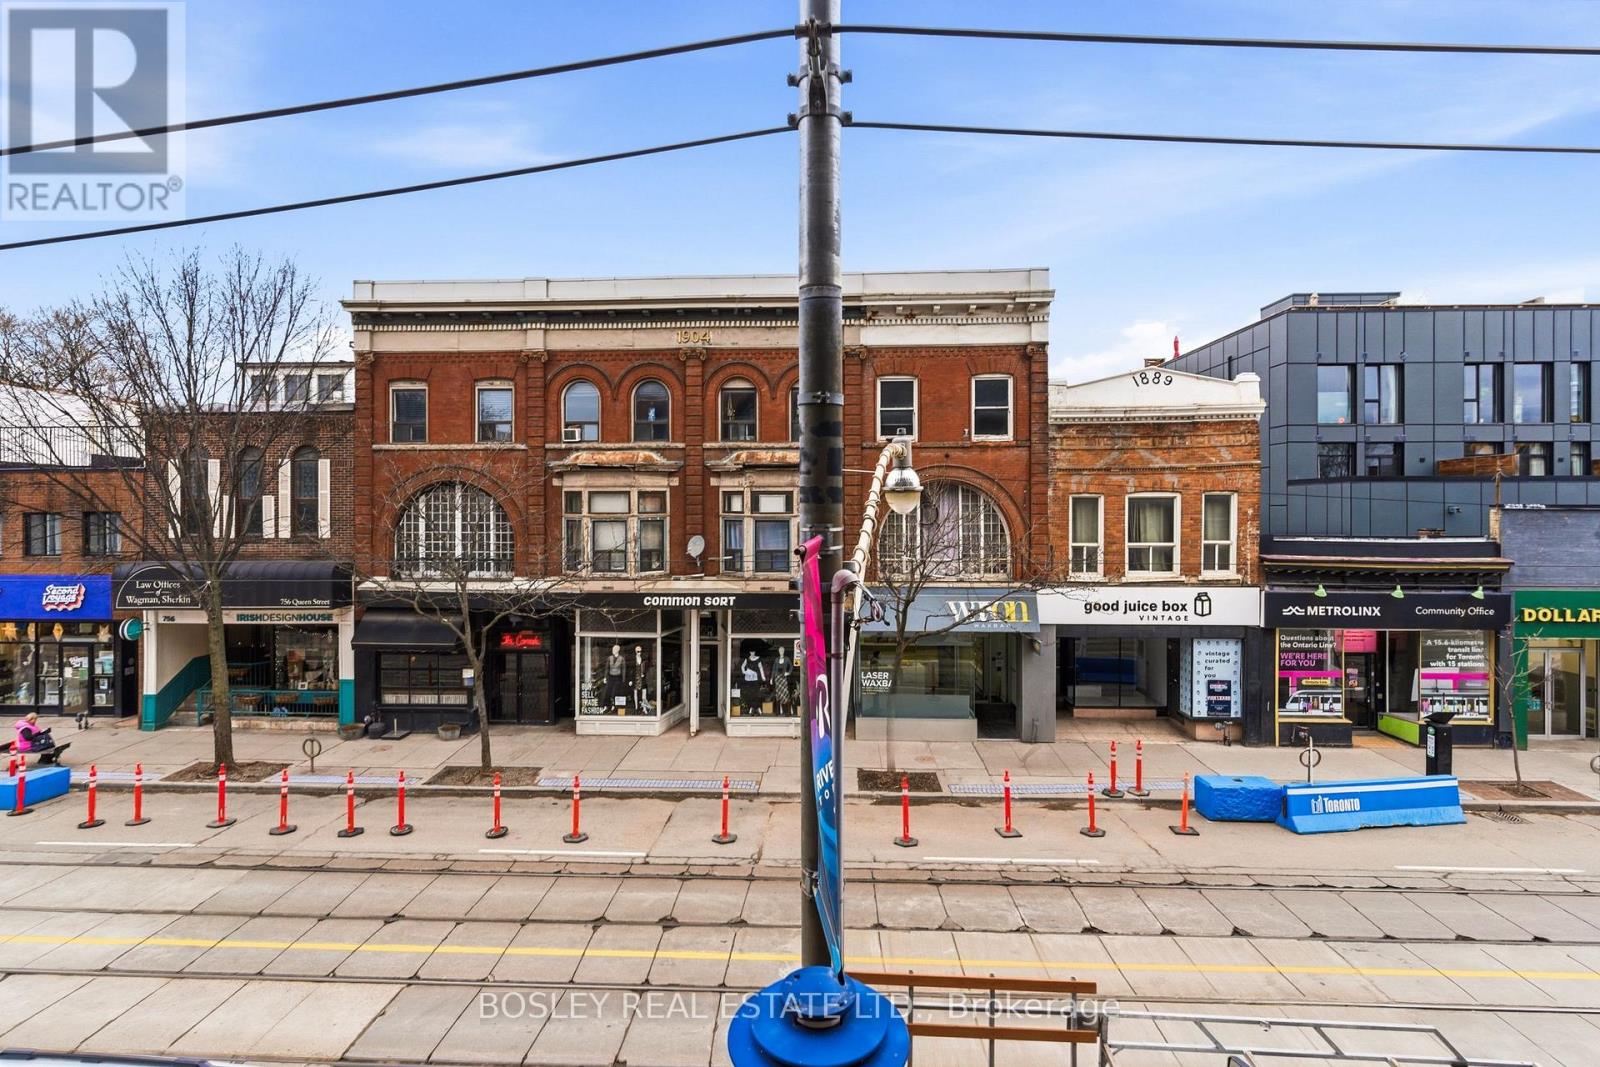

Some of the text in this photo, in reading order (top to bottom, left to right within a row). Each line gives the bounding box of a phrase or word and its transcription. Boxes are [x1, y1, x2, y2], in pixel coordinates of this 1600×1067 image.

[677, 330, 712, 344] 1904
[1132, 371, 1173, 387] 1889
[43, 583, 81, 596] Second
[136, 580, 181, 589] Law Offices
[126, 595, 160, 606] Wagman,
[292, 598, 312, 606] Queen
[1084, 600, 1188, 614] good juice box
[1307, 605, 1495, 617] METROLINX Community Office
[1306, 652, 1329, 660] HERE
[861, 671, 889, 679] LASER
[581, 690, 595, 698] SELL
[1322, 797, 1361, 813] TORONTO
